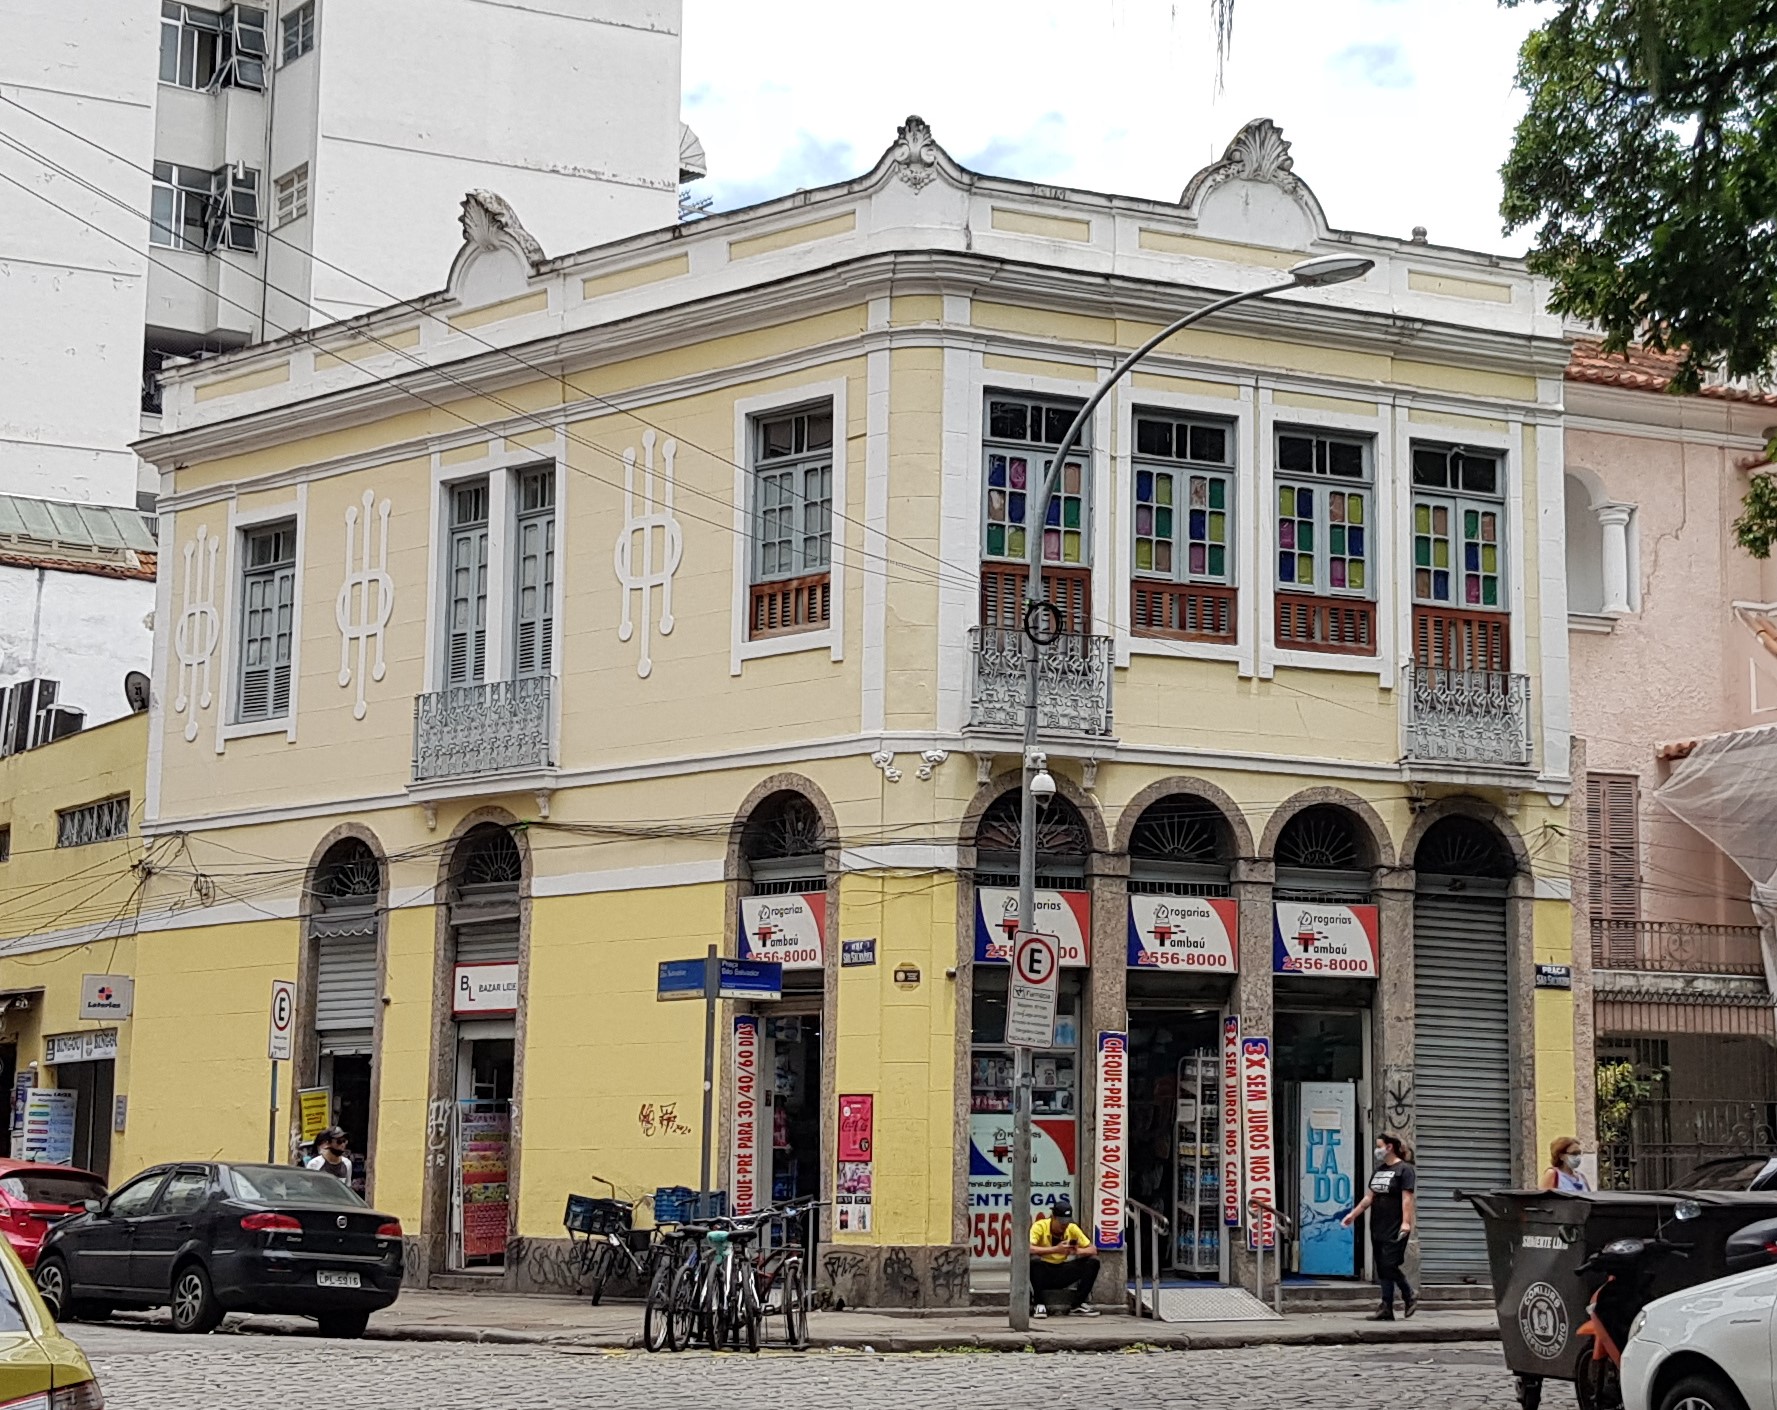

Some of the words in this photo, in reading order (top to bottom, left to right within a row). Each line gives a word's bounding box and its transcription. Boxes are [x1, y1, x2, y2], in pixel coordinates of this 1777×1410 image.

[1028, 948, 1042, 974] E
[1138, 950, 1227, 966] 2556-8000
[1282, 956, 1368, 971] 2556-8000
[479, 983, 500, 992] BAZAR
[278, 997, 286, 1022] E
[738, 1023, 754, 1046] DIAS
[1225, 1052, 1237, 1078] SEM
[737, 1050, 755, 1118] 30/40/60
[1246, 1073, 1268, 1101] SEM
[1225, 1083, 1237, 1124] JUROS
[738, 1121, 753, 1149] PARA
[1103, 1113, 1121, 1142] PARA
[1247, 1108, 1270, 1150] JUROS
[1225, 1130, 1237, 1155] NOS
[1099, 1144, 1121, 1216] 30/40/60
[1249, 1155, 1270, 1182] NOS
[968, 1193, 1070, 1207] ENTRGAS
[1101, 1220, 1119, 1243] DIAS
